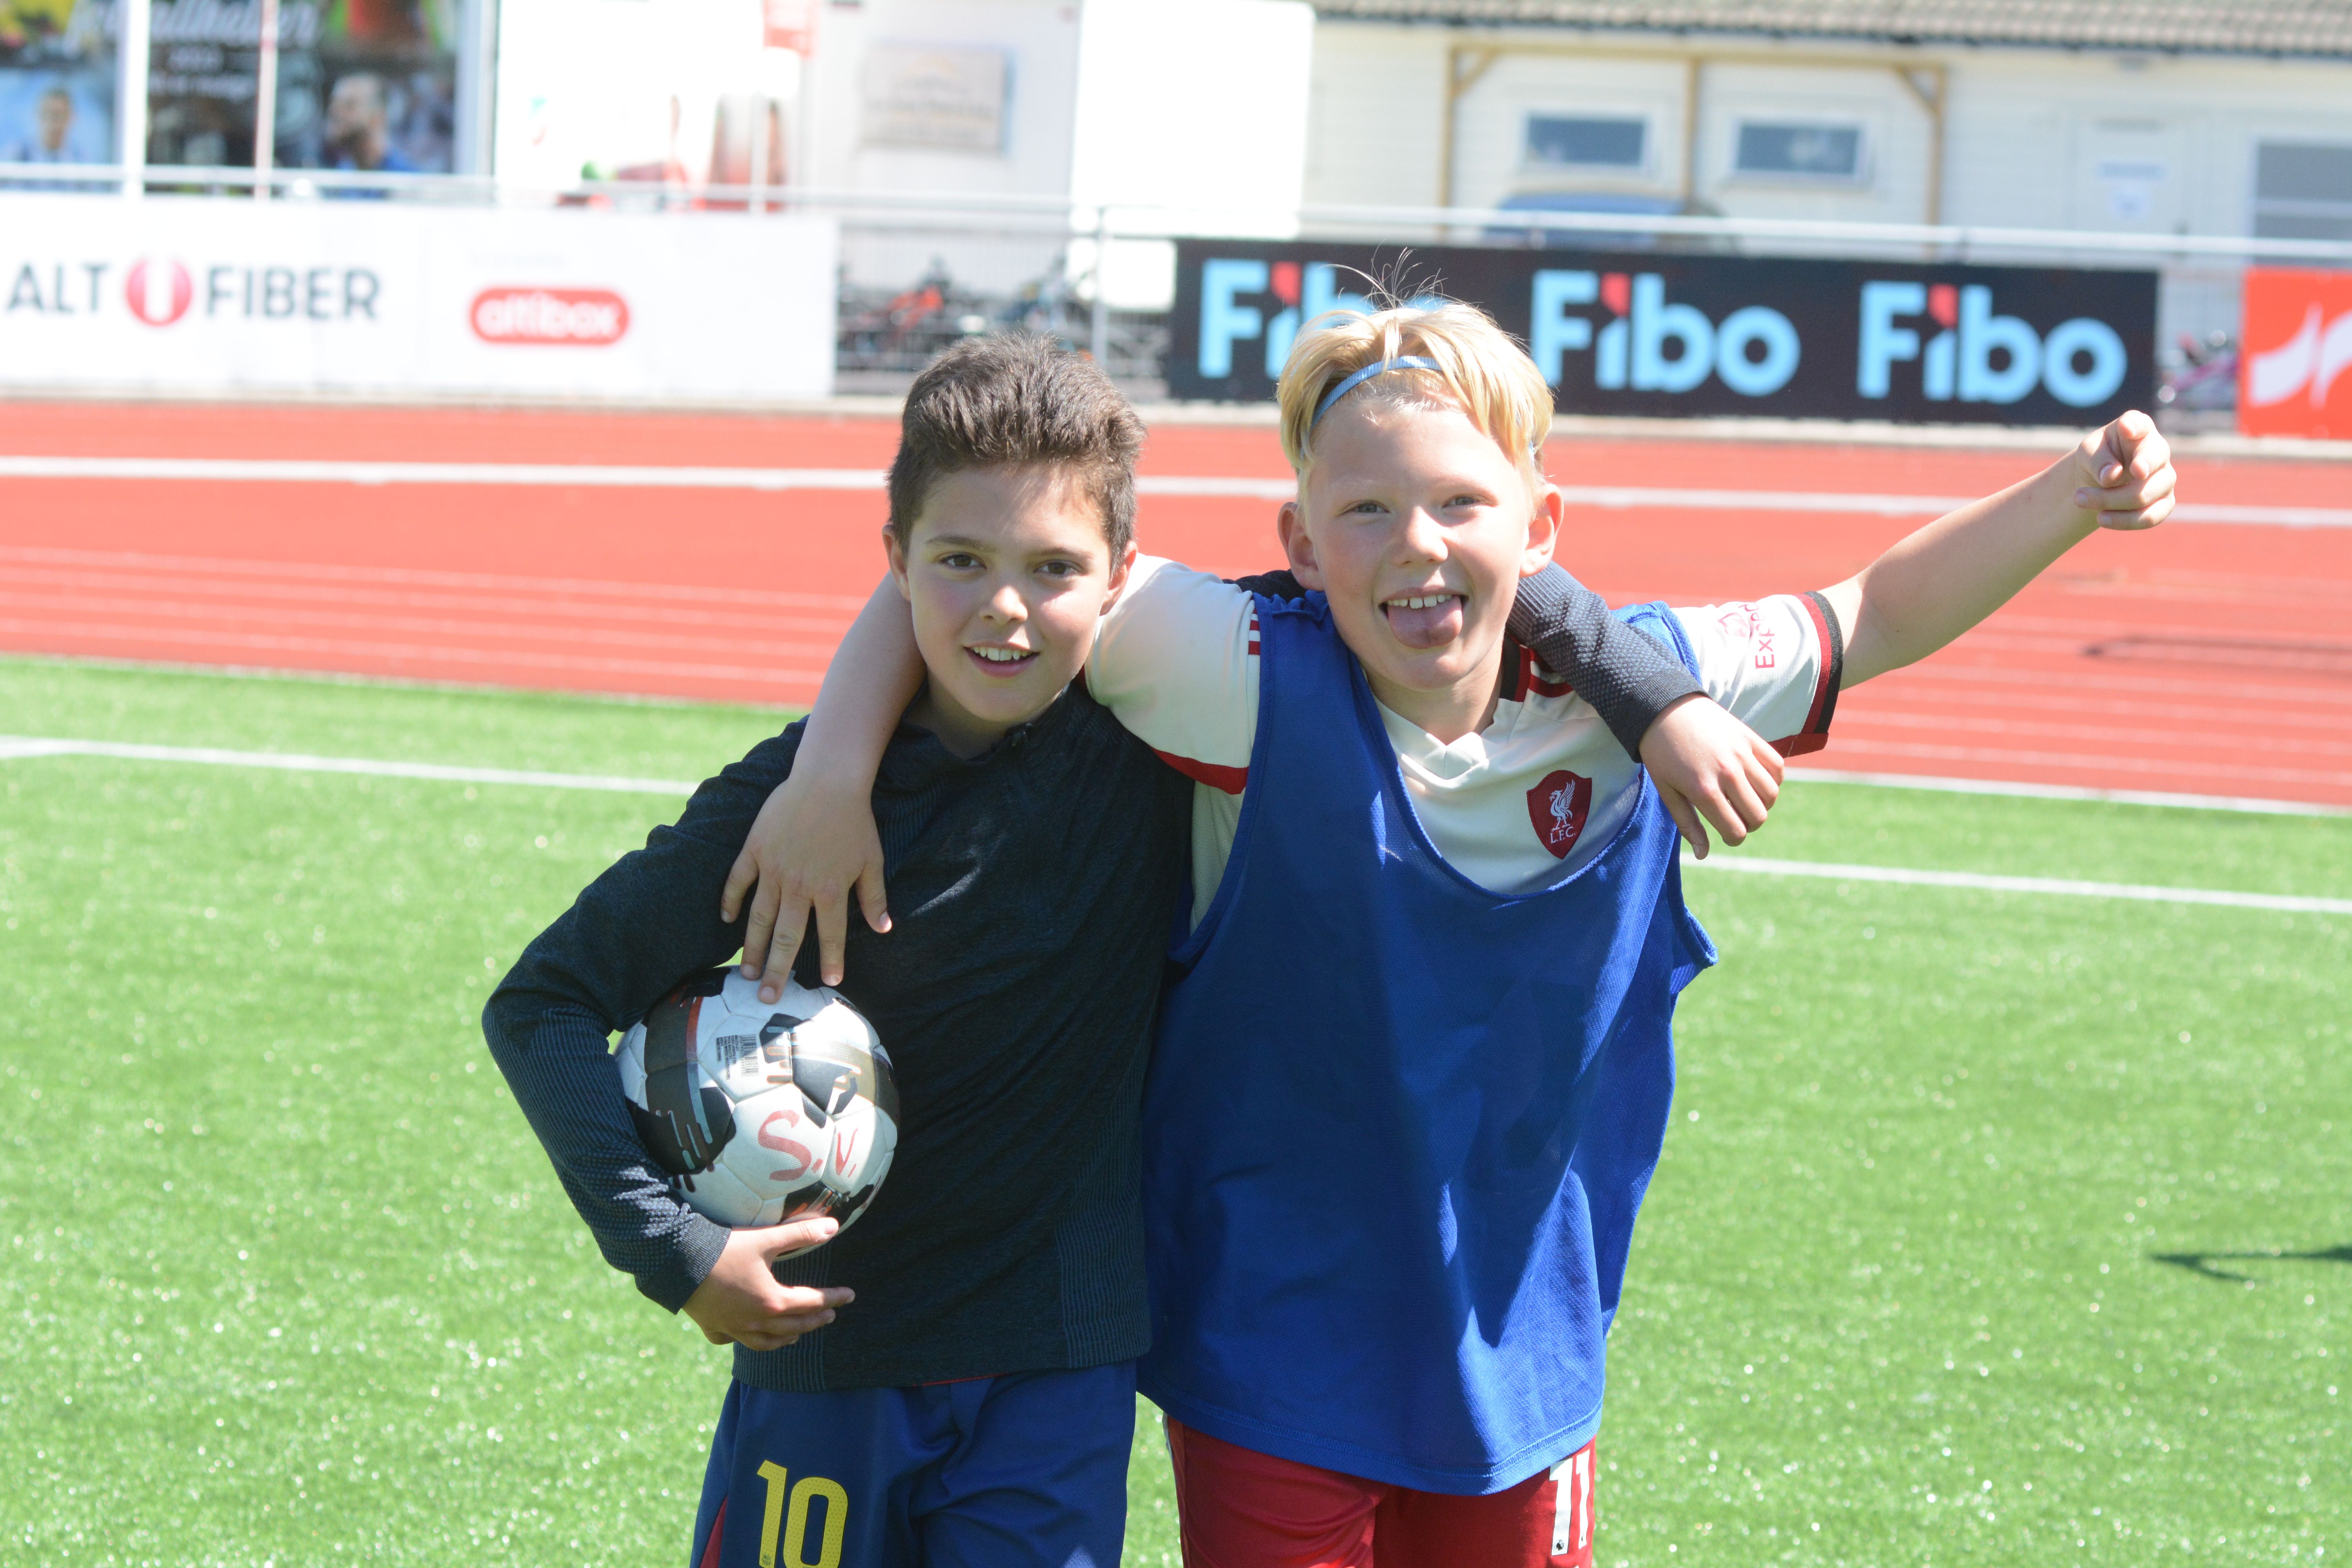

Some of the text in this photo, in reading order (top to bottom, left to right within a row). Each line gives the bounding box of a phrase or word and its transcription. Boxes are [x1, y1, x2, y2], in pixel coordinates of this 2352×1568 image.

[7, 262, 381, 321] ALT FIBER
[475, 291, 622, 339] altibox
[1198, 258, 2129, 408] Fi Fibo Fibo
[1550, 826, 1576, 844] L.F.C.
[757, 1459, 848, 1568] 10
[1549, 1449, 1590, 1556] 11
